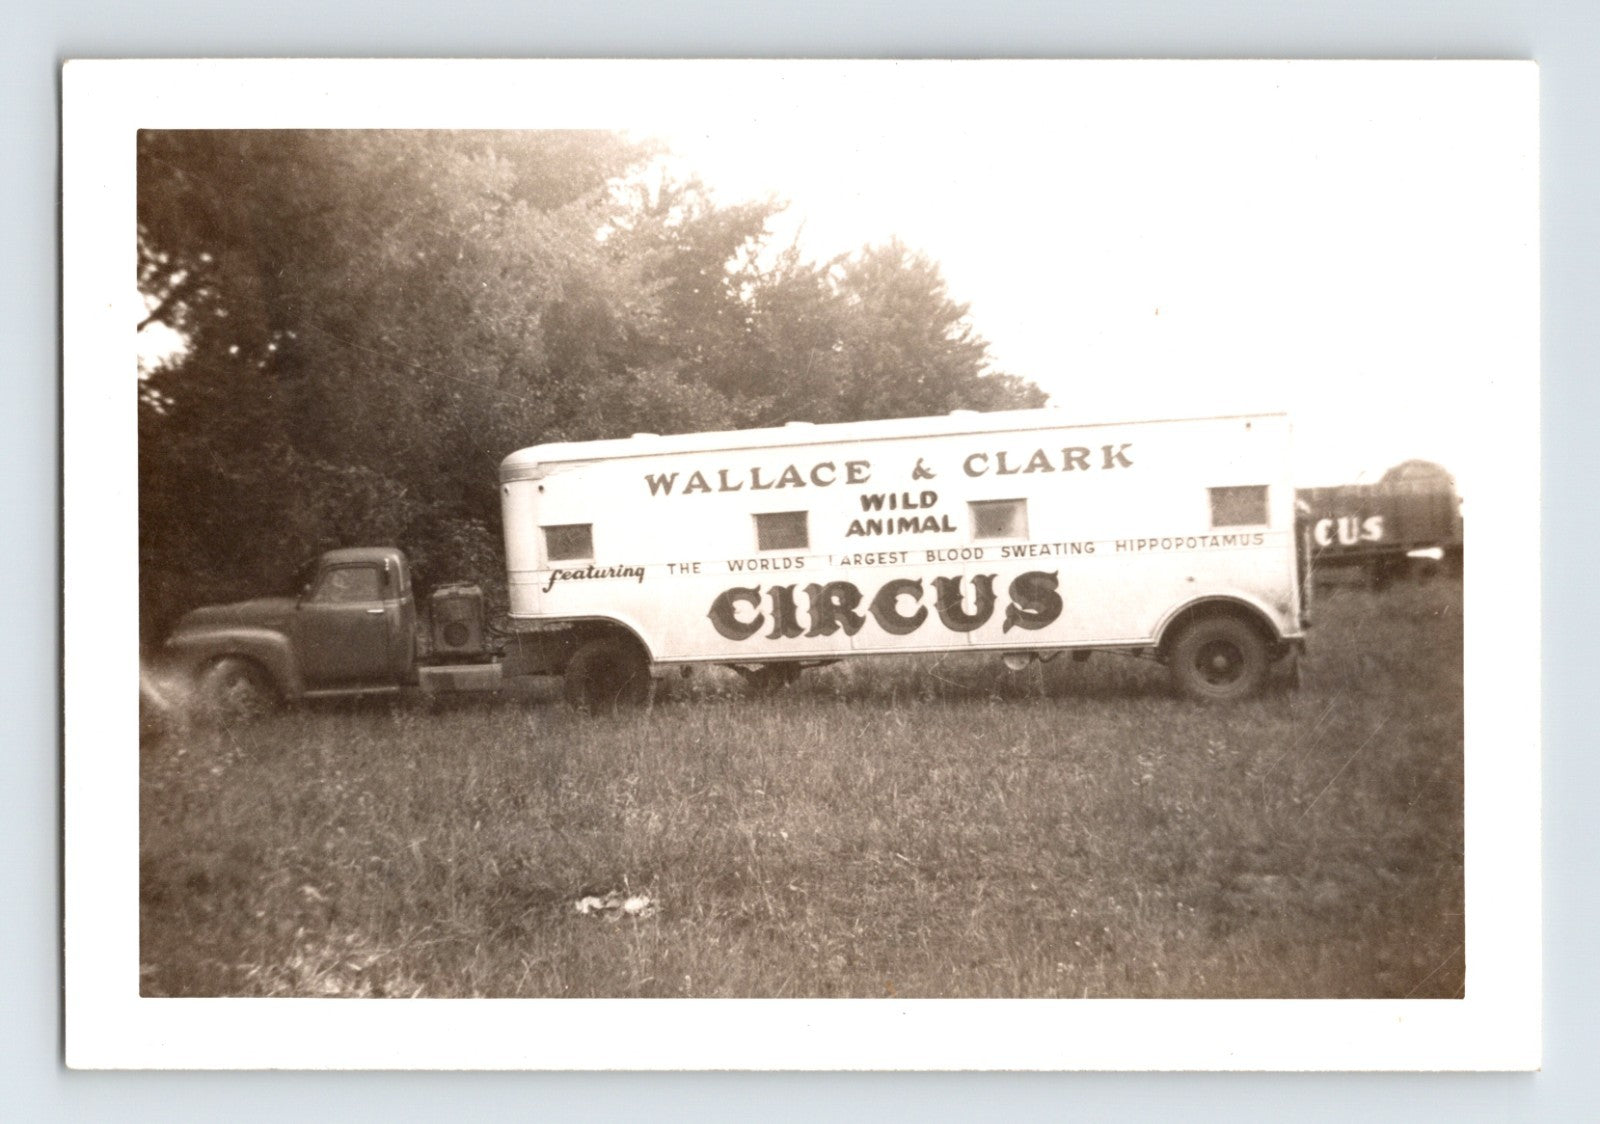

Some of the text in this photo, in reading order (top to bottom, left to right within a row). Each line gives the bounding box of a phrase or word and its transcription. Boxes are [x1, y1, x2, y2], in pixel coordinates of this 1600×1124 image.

[645, 443, 1134, 497] WALLACE & CLARK
[845, 515, 957, 537] ANIMAL
[860, 490, 938, 512] WILD
[542, 564, 645, 593] featuring
[667, 562, 701, 575] THE
[727, 556, 806, 572] WORLDS
[926, 548, 984, 563] BLOOD
[1000, 541, 1096, 558] SWEATING
[1115, 533, 1265, 552] HIPPOPOTAMUS
[706, 570, 1064, 641] CIRCUS
